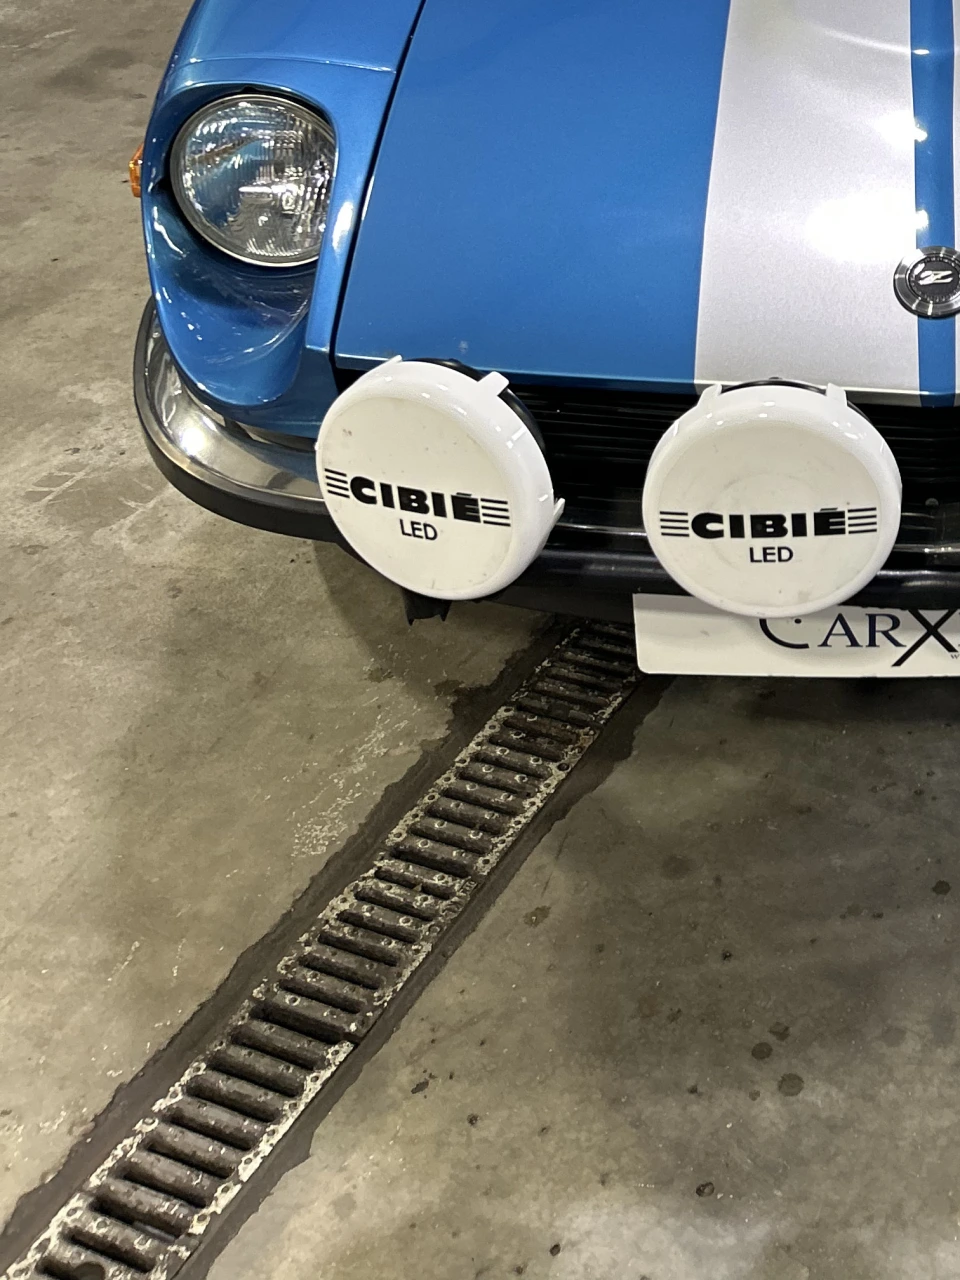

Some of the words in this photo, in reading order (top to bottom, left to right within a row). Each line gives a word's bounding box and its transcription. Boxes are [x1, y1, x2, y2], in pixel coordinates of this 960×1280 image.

[350, 476, 481, 523] CIBIÉ
[400, 519, 438, 541] LED
[691, 507, 846, 539] CIBIÉ
[749, 546, 794, 563] LED
